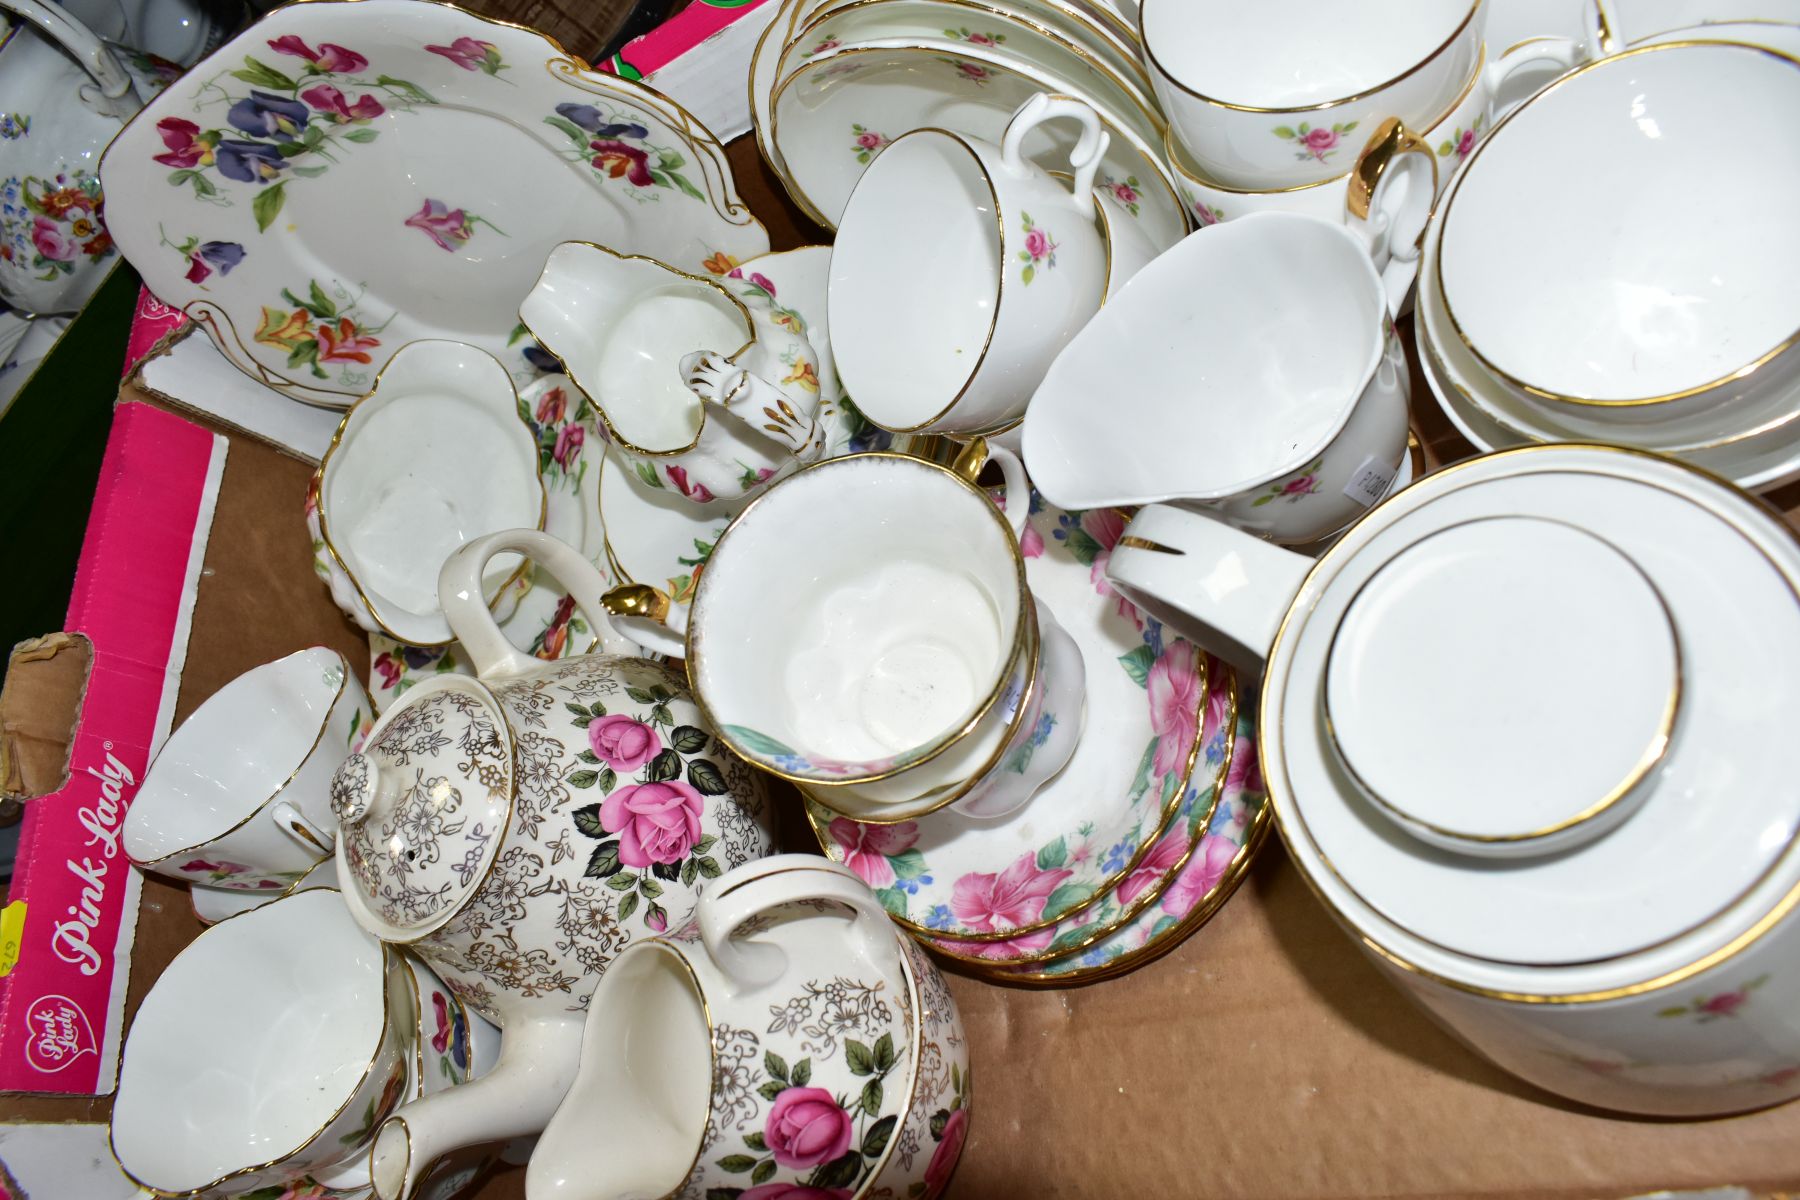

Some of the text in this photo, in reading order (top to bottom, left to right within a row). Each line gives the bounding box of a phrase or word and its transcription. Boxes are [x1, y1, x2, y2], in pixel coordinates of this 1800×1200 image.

[52, 857, 107, 976] Pink
[34, 1006, 79, 1060] Pink Lady
